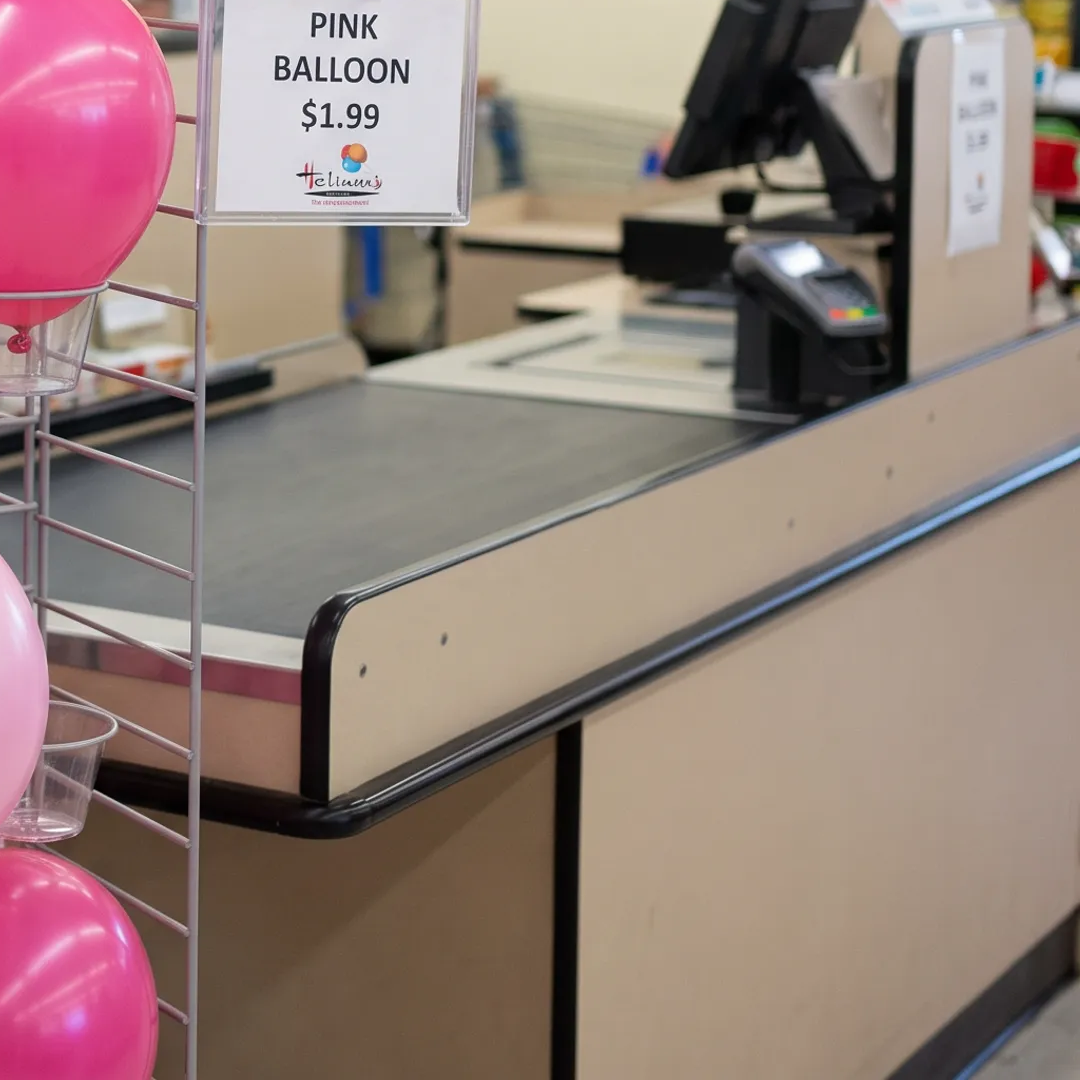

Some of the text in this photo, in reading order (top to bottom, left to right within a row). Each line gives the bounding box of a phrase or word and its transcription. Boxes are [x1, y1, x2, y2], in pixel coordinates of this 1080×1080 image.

[310, 12, 378, 40] PINK
[274, 55, 410, 84] BALLOON
[301, 98, 380, 132] $1.99
